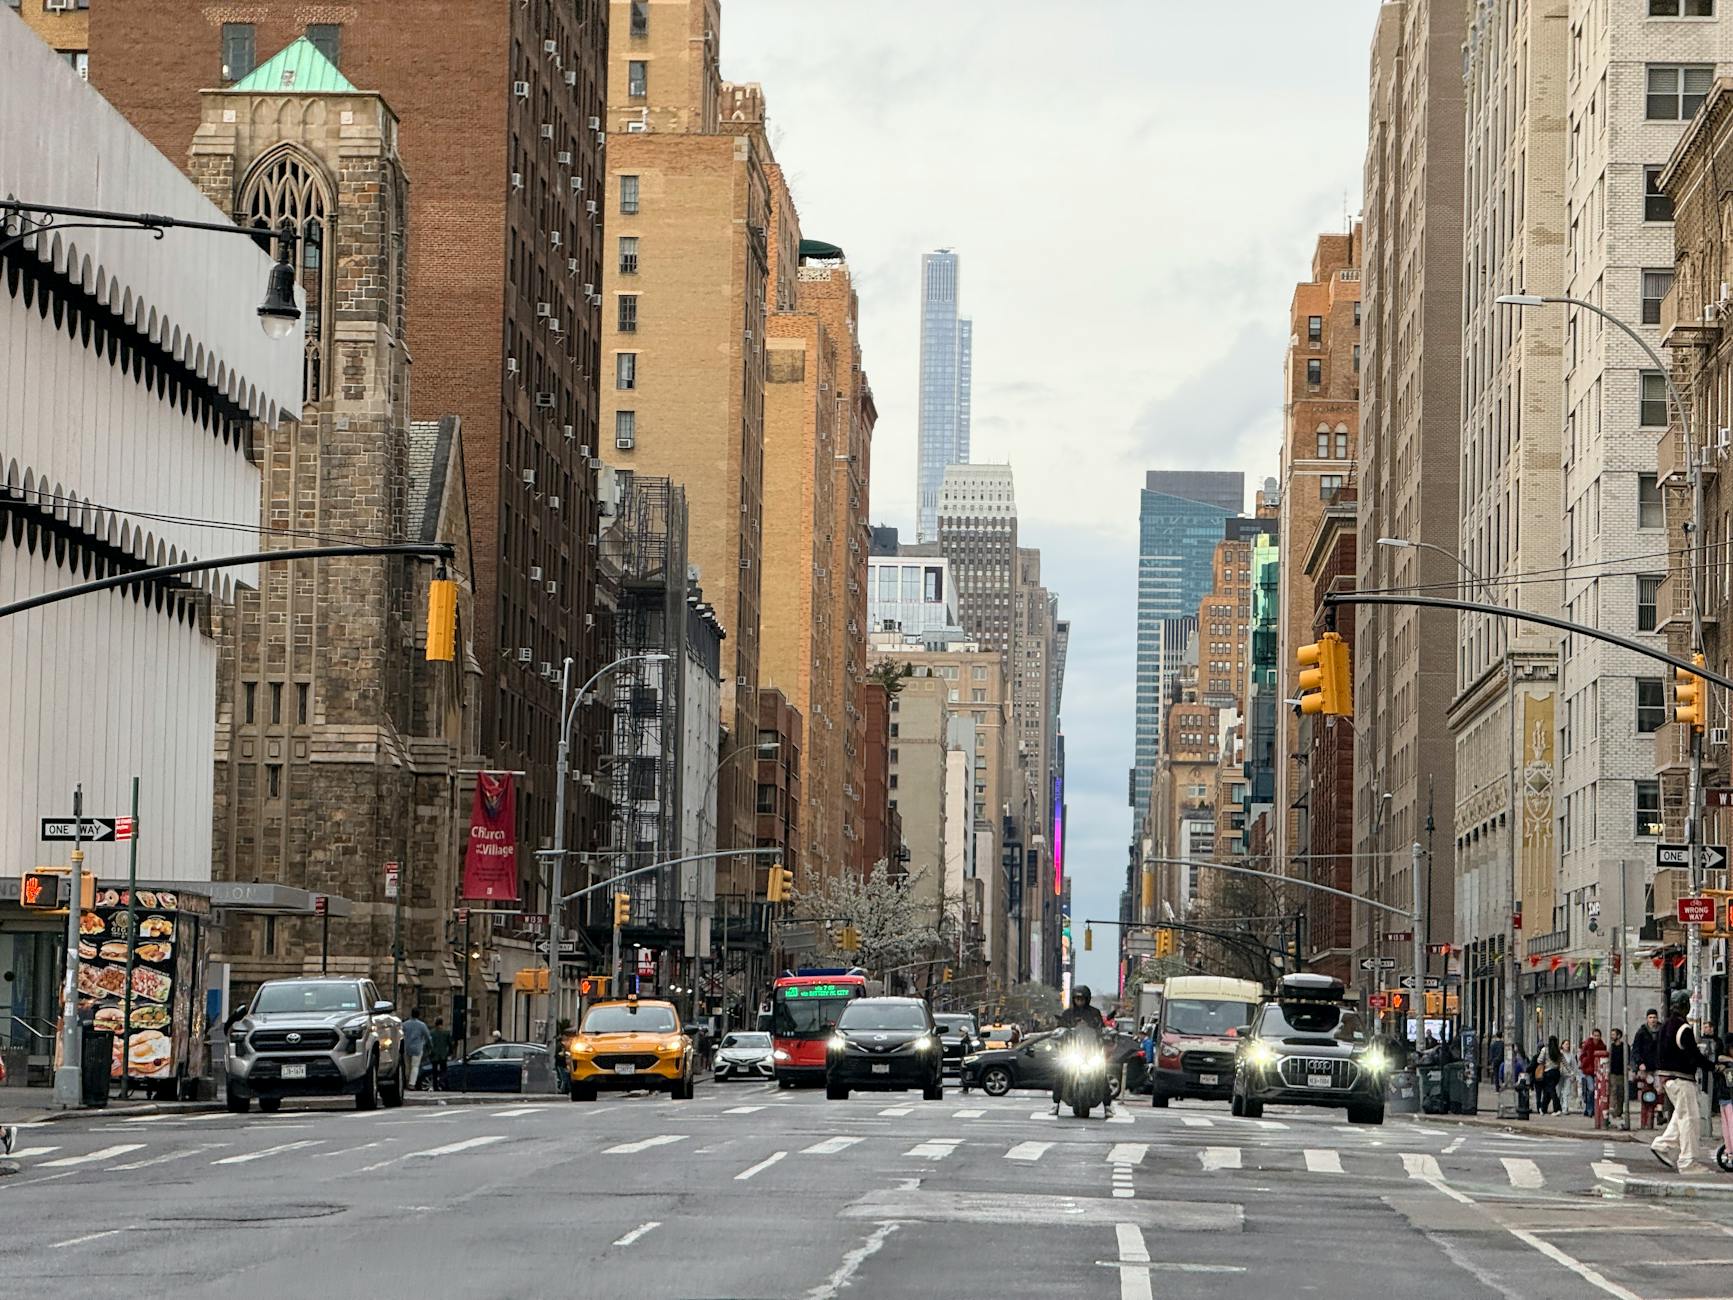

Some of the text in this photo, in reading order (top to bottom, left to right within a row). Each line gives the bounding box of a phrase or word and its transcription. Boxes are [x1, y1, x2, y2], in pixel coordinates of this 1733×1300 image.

[1719, 793, 1728, 805] W
[48, 825, 101, 834] ONE WAY
[471, 826, 505, 840] Church
[483, 844, 514, 857] Village
[1663, 851, 1683, 861] ONE
[1684, 906, 1709, 914] WRONG
